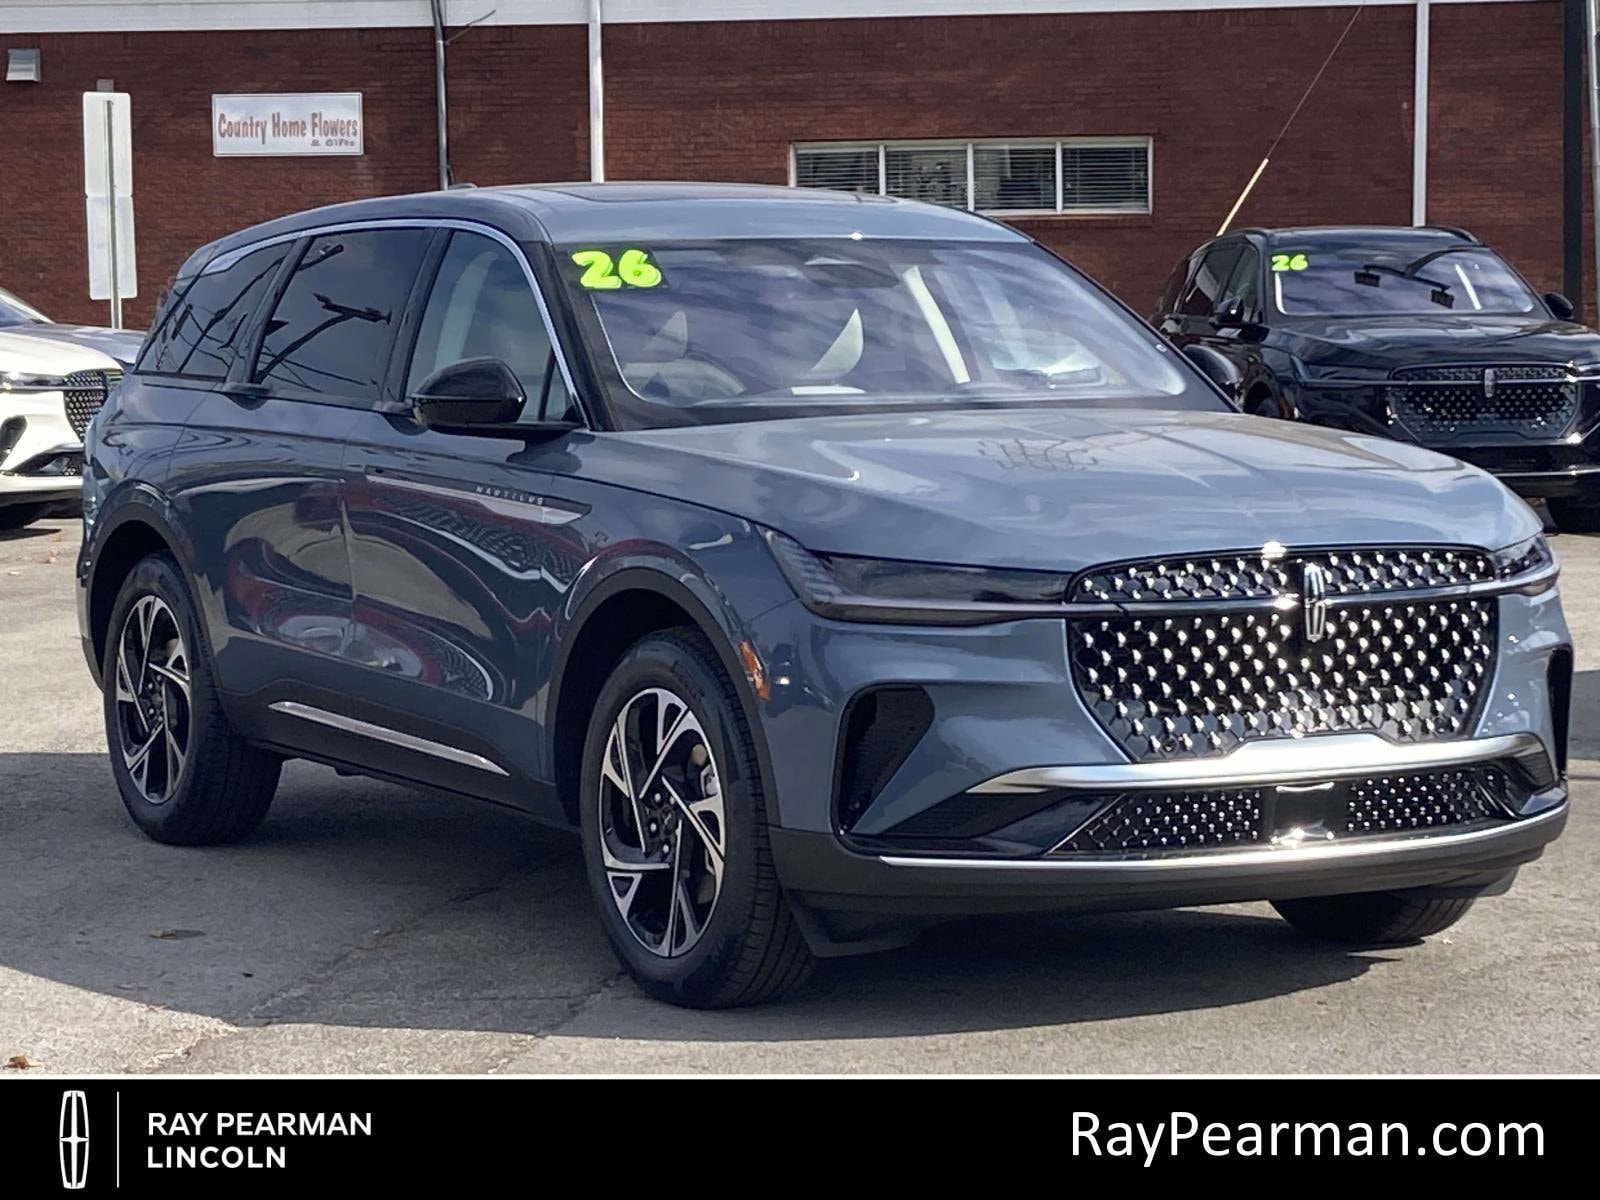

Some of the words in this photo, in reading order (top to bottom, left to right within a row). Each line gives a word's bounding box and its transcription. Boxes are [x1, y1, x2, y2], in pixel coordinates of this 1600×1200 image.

[218, 112, 268, 145] Country
[271, 112, 308, 138] Home
[311, 111, 359, 138] Flowers
[571, 249, 662, 289] 26
[1271, 254, 1308, 271] 26
